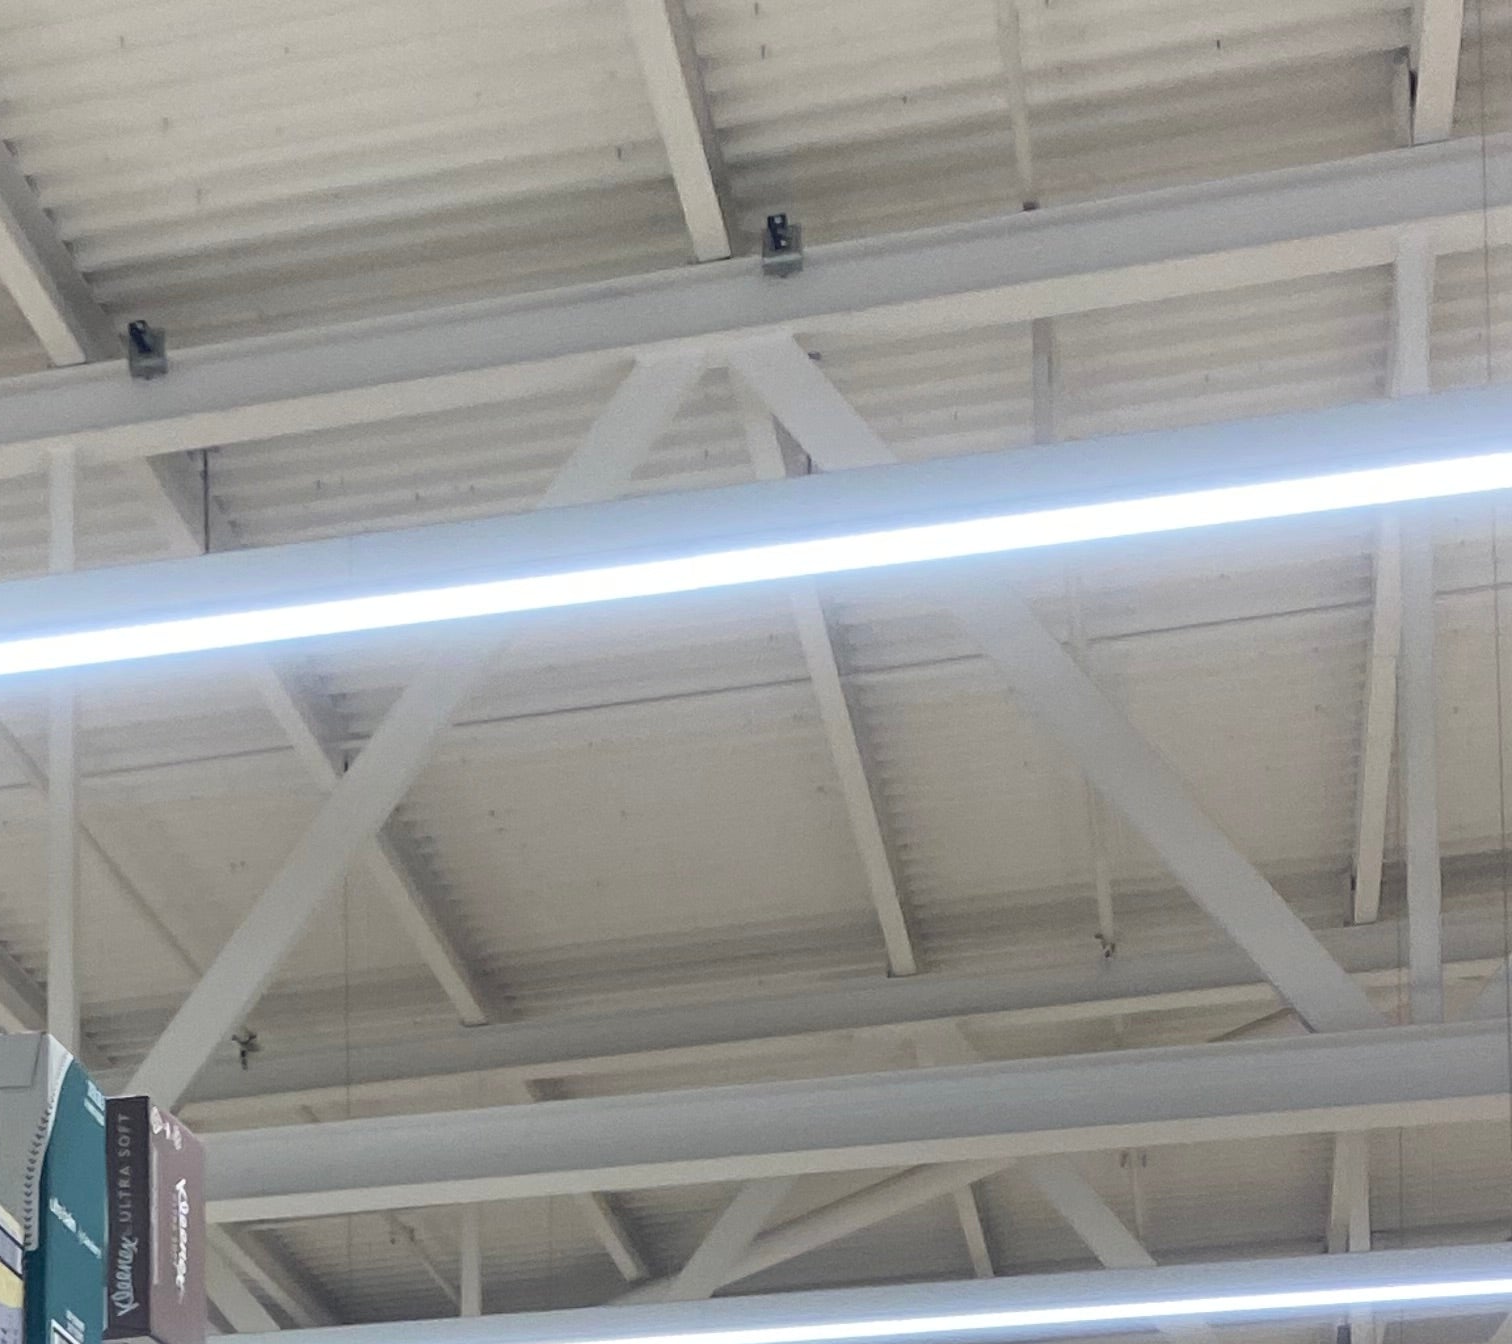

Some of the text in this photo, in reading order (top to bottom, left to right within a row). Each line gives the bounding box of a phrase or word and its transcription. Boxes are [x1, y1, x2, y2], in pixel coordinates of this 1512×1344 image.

[111, 1113, 138, 1317] Kleenex ULTRA SOFT
